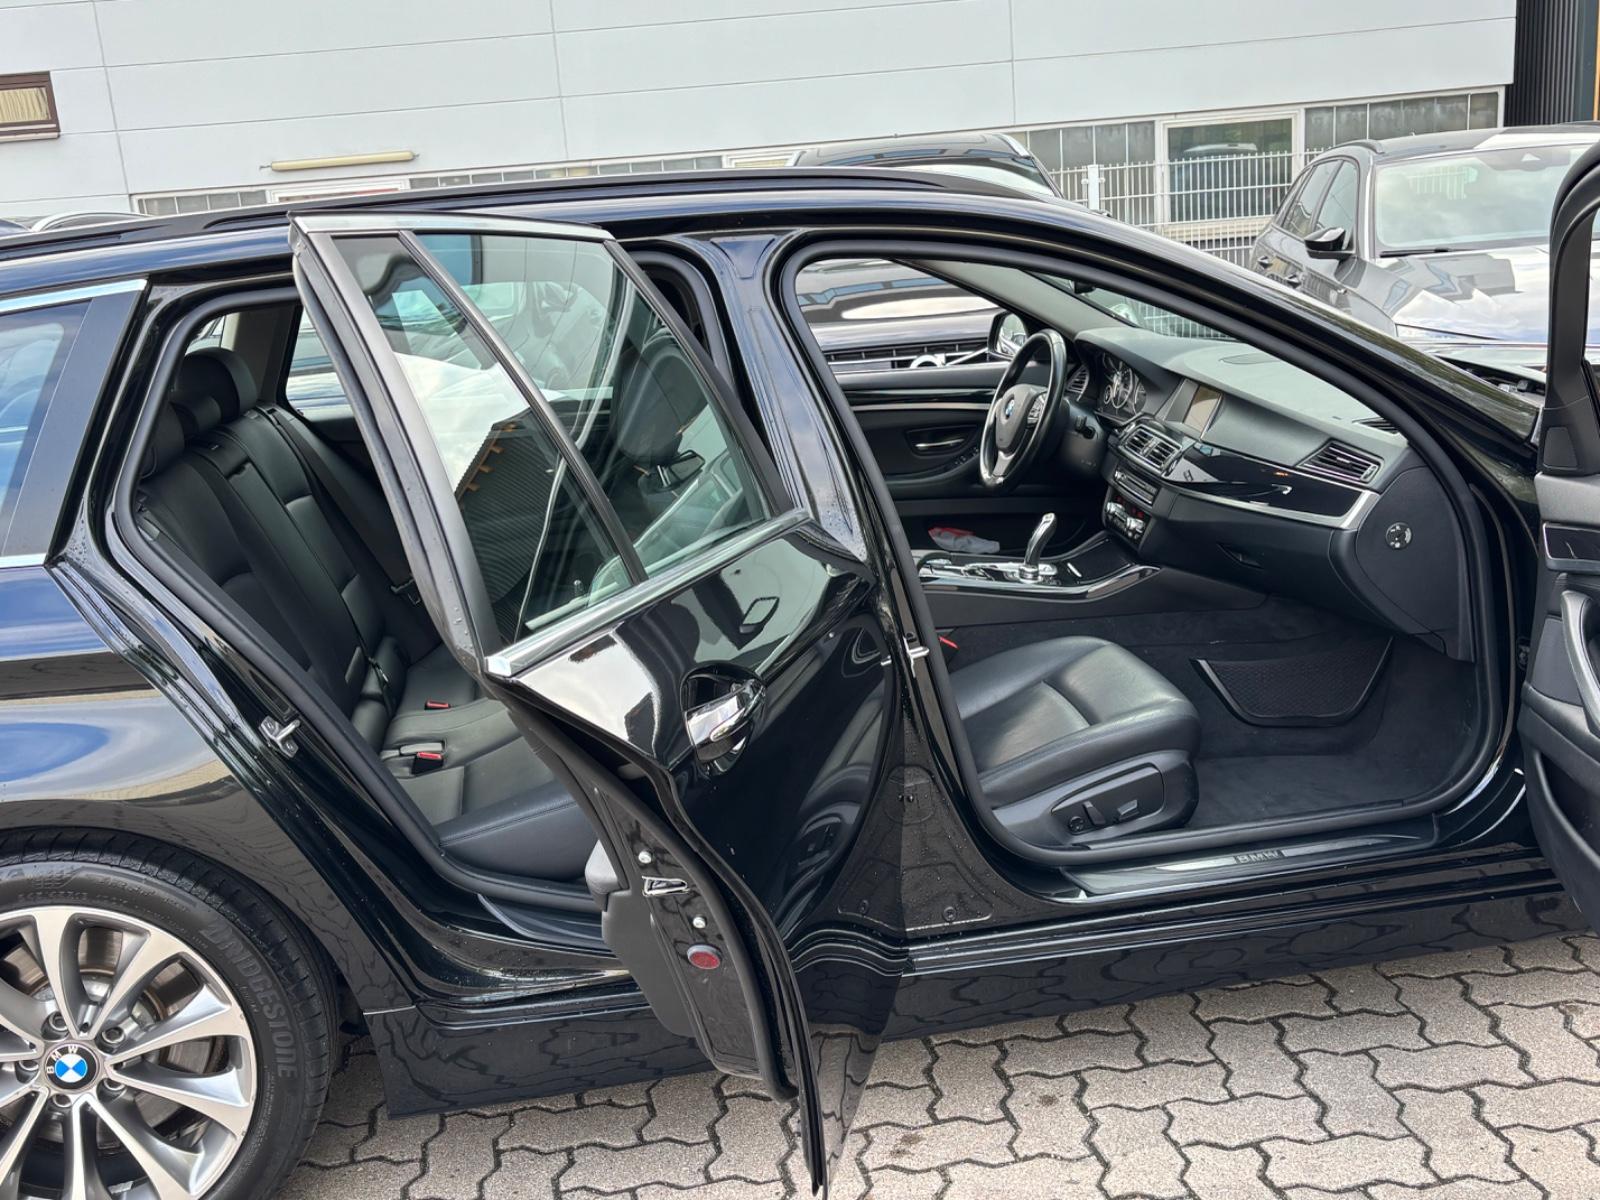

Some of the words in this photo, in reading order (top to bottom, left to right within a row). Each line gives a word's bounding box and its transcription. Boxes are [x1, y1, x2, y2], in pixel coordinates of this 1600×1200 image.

[1236, 850, 1279, 863] BMW
[200, 920, 298, 1079] BRIDGESTONE
[46, 1044, 79, 1074] BMW
